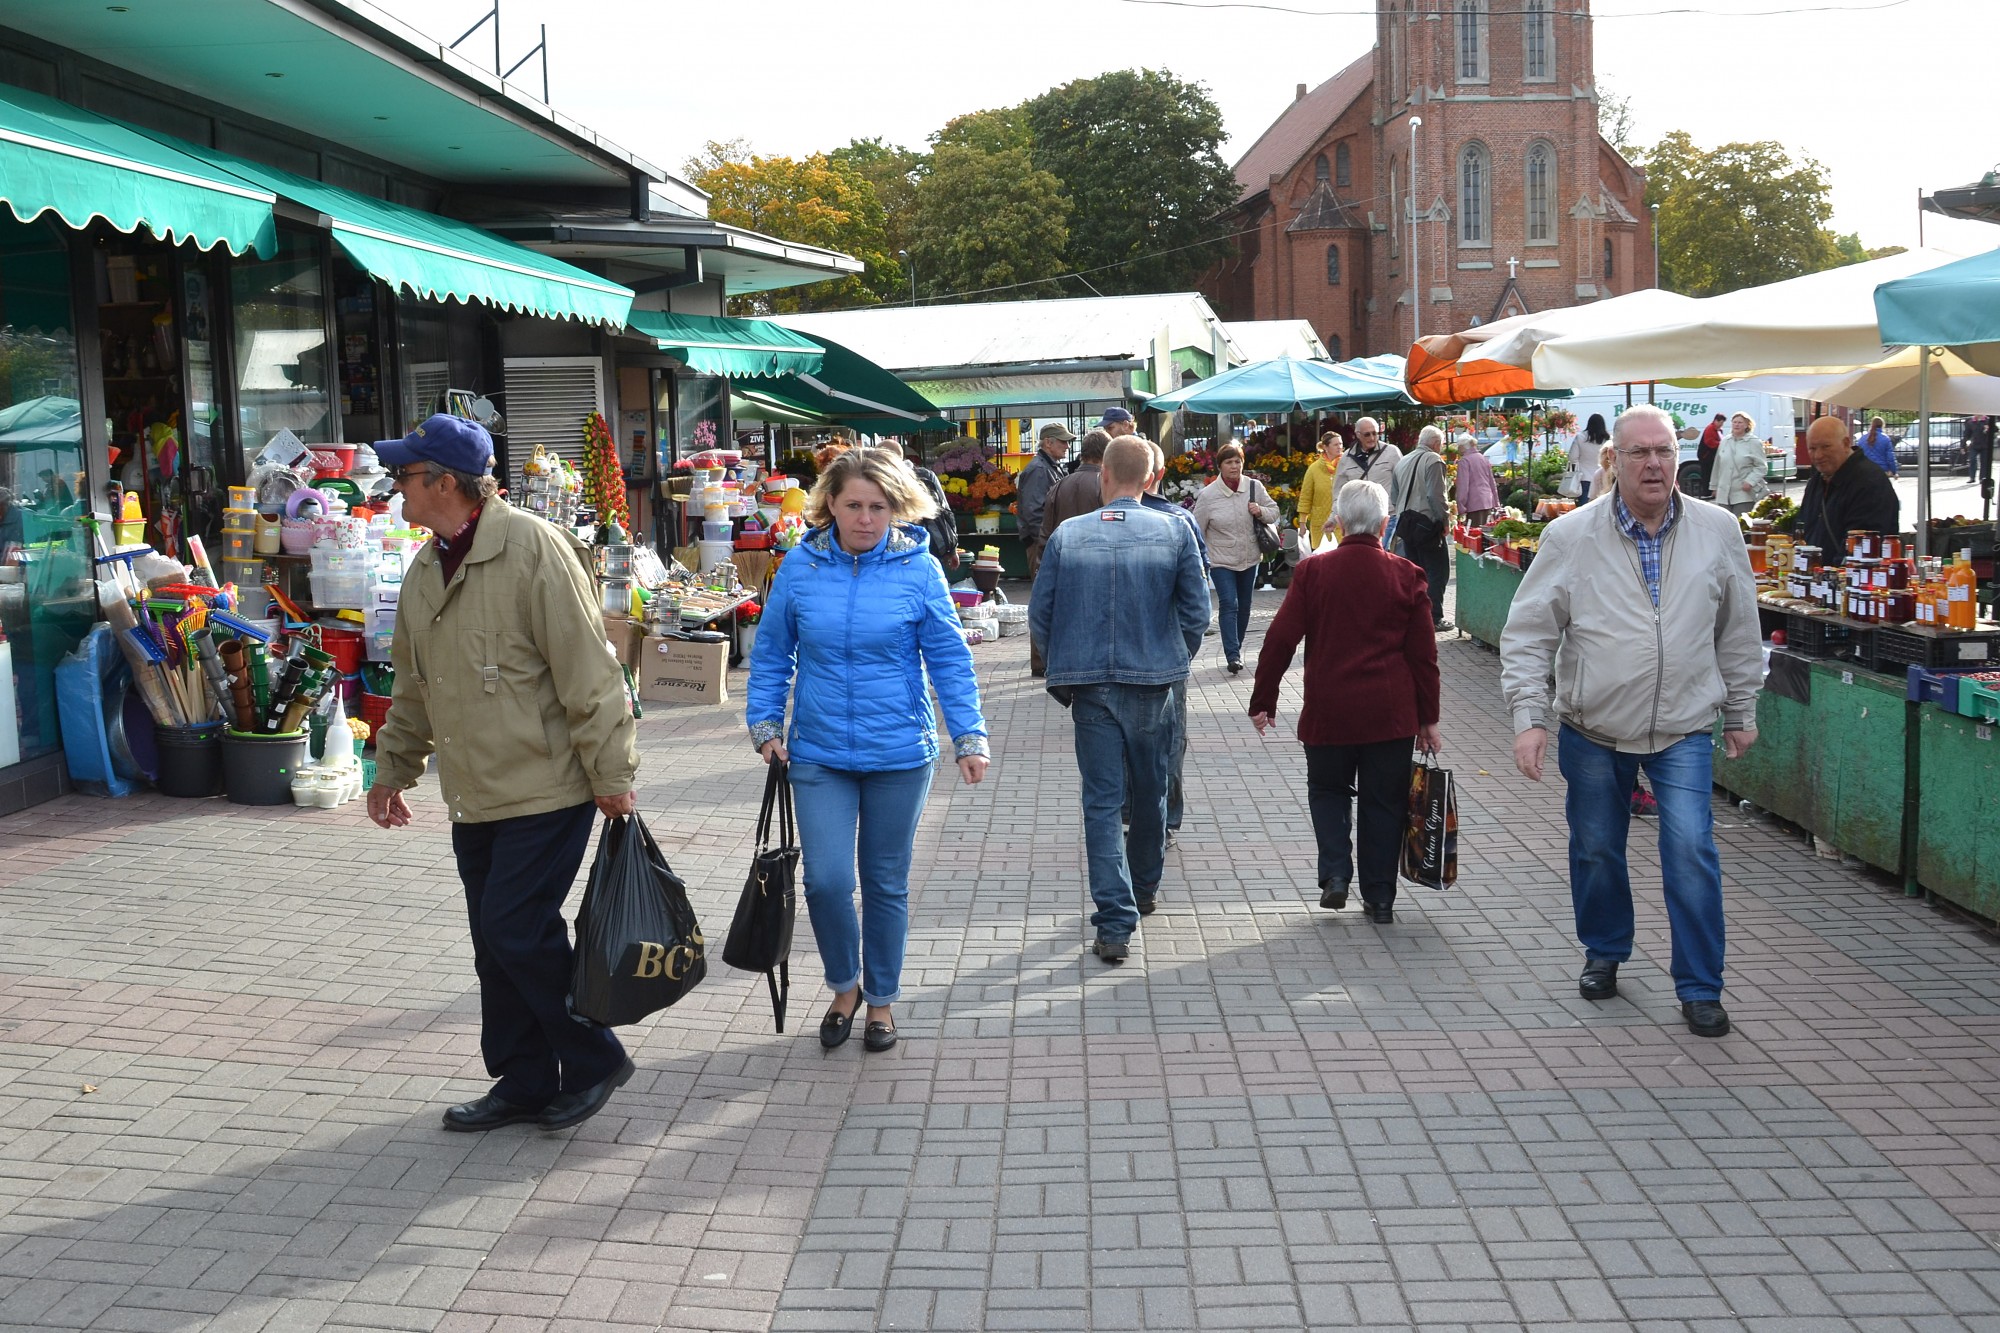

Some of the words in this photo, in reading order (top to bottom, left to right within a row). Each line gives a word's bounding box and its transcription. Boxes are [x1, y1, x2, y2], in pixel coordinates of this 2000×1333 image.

[1614, 399, 1708, 416] Rnbergs
[750, 435, 765, 443] ZIVI
[1425, 799, 1442, 831] Cigars
[1422, 835, 1436, 870] Cuban
